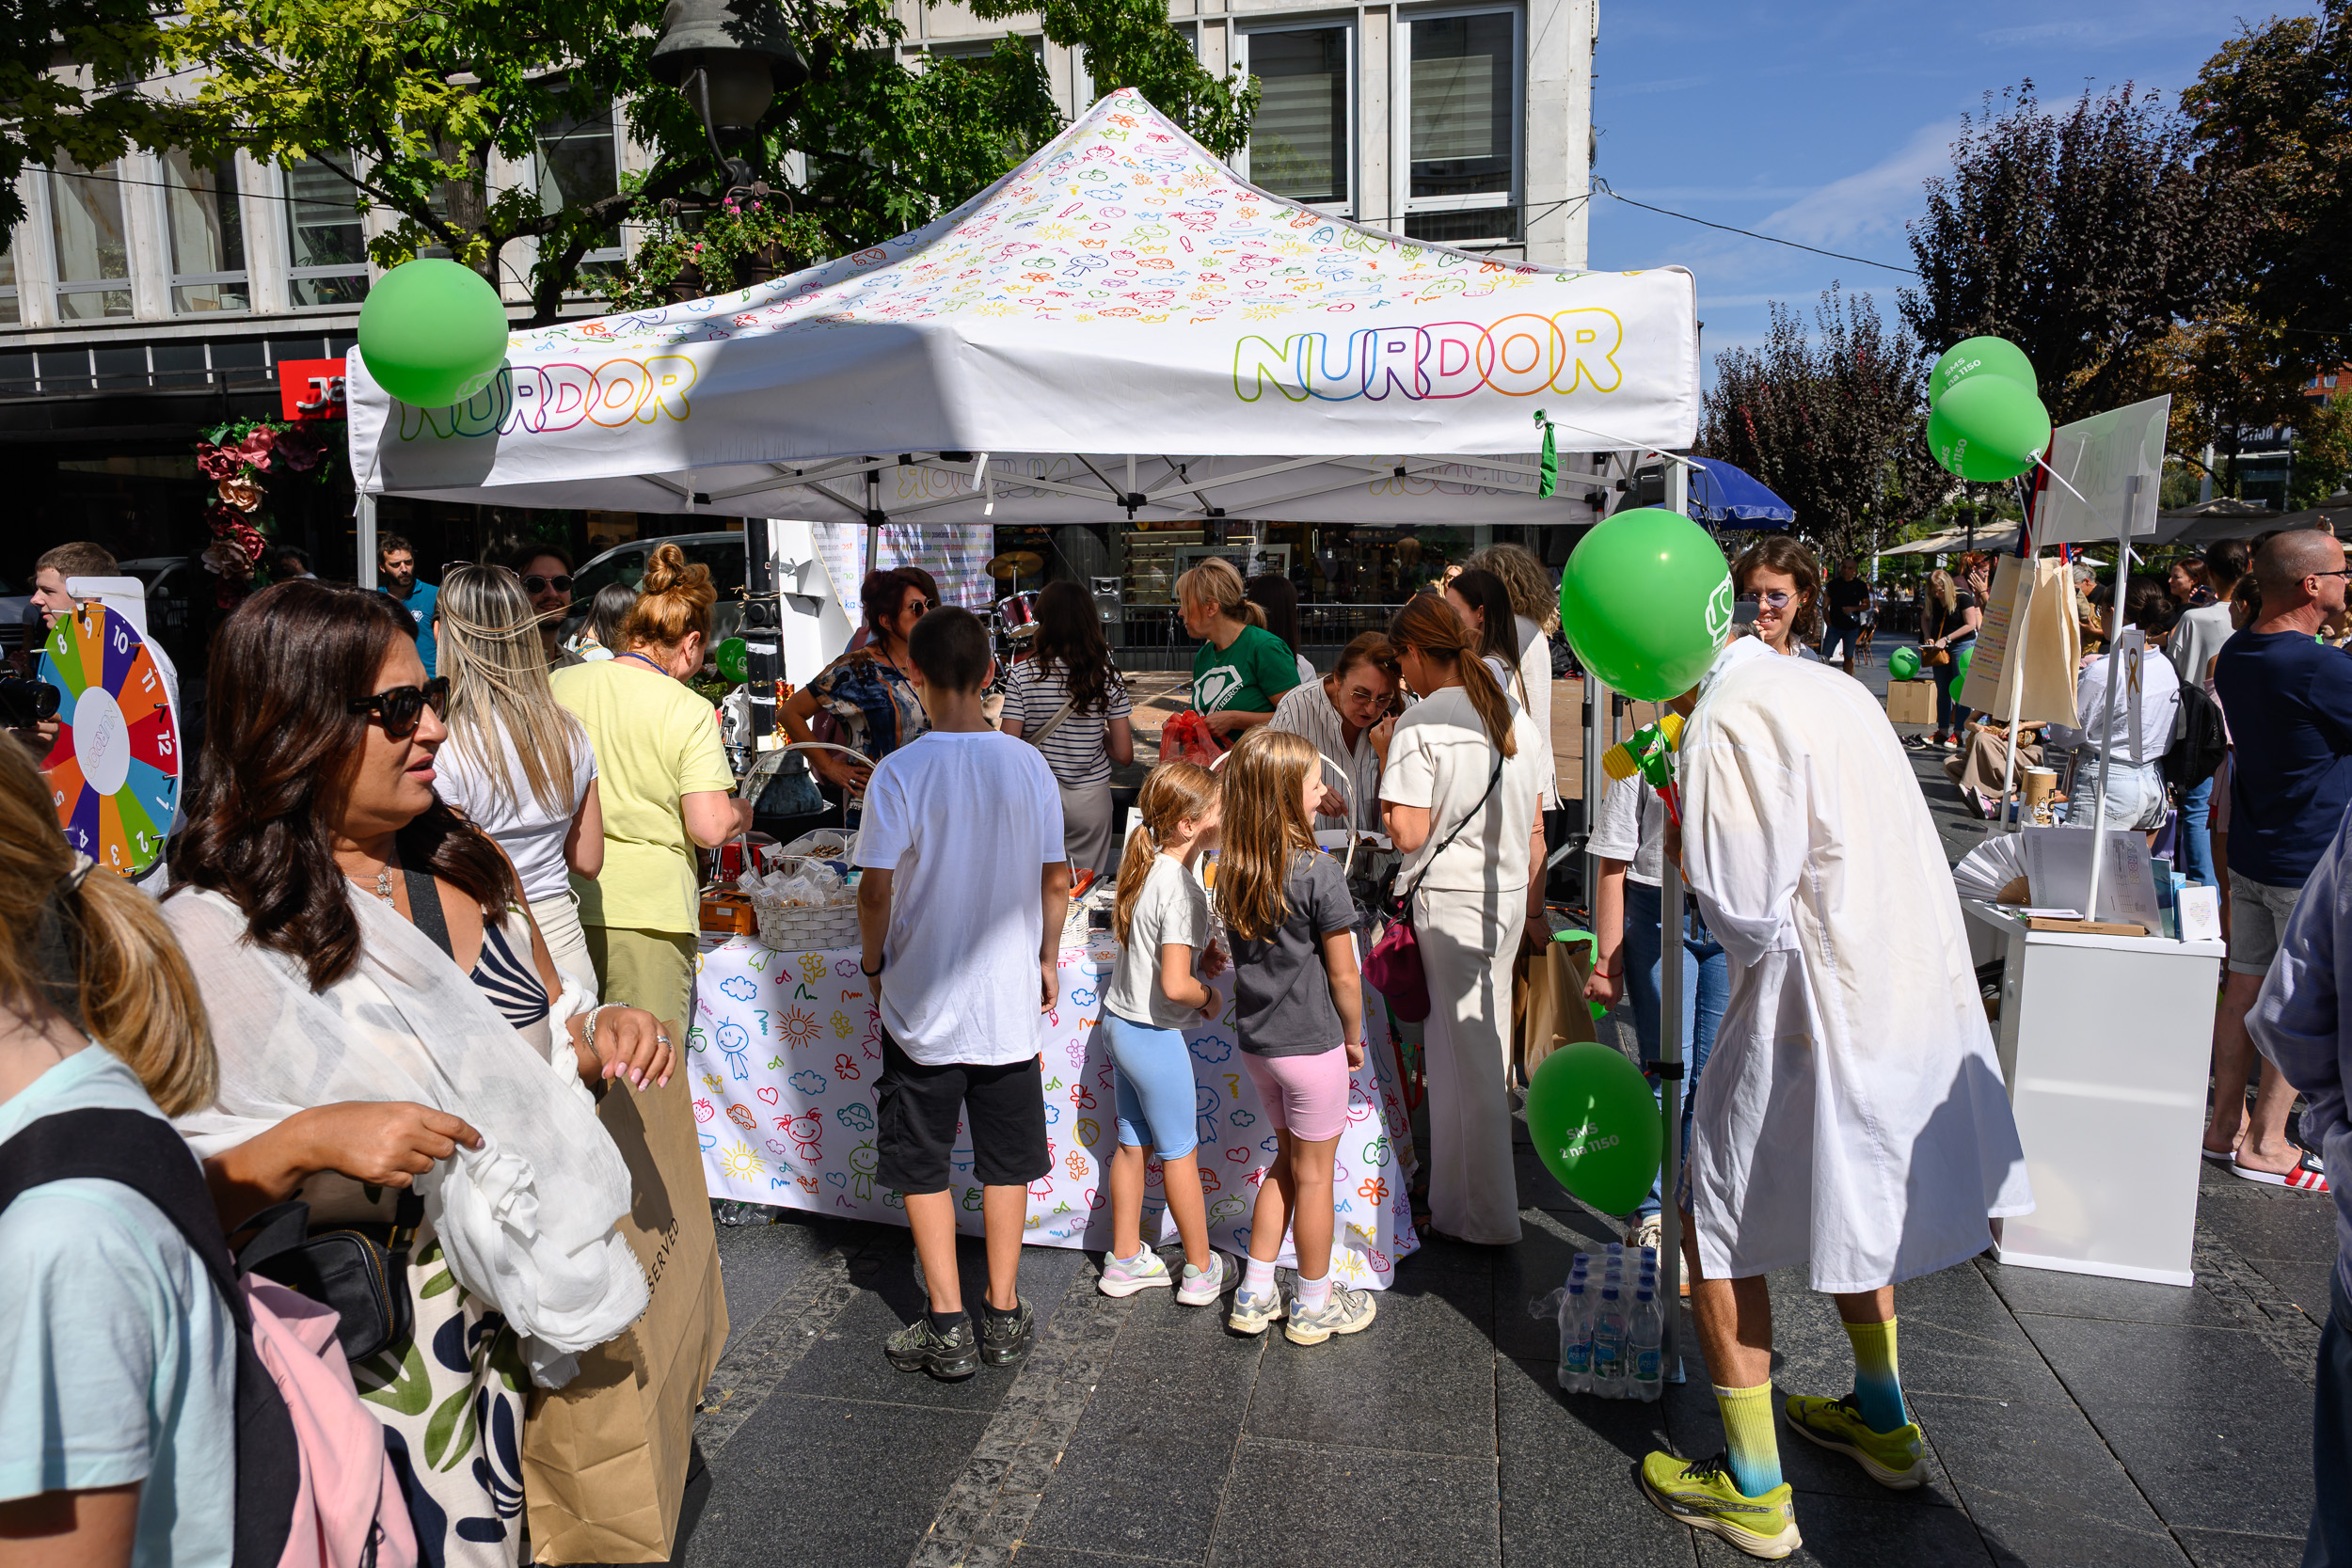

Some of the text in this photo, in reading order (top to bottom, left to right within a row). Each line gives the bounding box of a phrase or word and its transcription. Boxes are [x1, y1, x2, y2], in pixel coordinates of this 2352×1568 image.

[1233, 307, 1623, 403] NURDOR
[1944, 356, 1966, 377] SMS
[1959, 359, 1981, 375] 1150
[1941, 445, 1950, 467] SMS
[1954, 438, 1967, 463] 1150
[84, 617, 93, 640] 9
[113, 625, 129, 655] 10
[56, 633, 68, 656] 8
[141, 667, 157, 693] 11
[83, 700, 120, 780] NURDOR
[156, 729, 173, 757] 12
[53, 790, 65, 808] 5
[156, 796, 170, 812] 1
[79, 829, 89, 849] 4
[135, 830, 150, 853] 2
[110, 844, 121, 866] 3
[2125, 839, 2141, 886] NURDOR
[1565, 1122, 1599, 1141] SMS
[1559, 1134, 1620, 1159] 2 na 1150
[642, 1217, 679, 1309] SERVED
